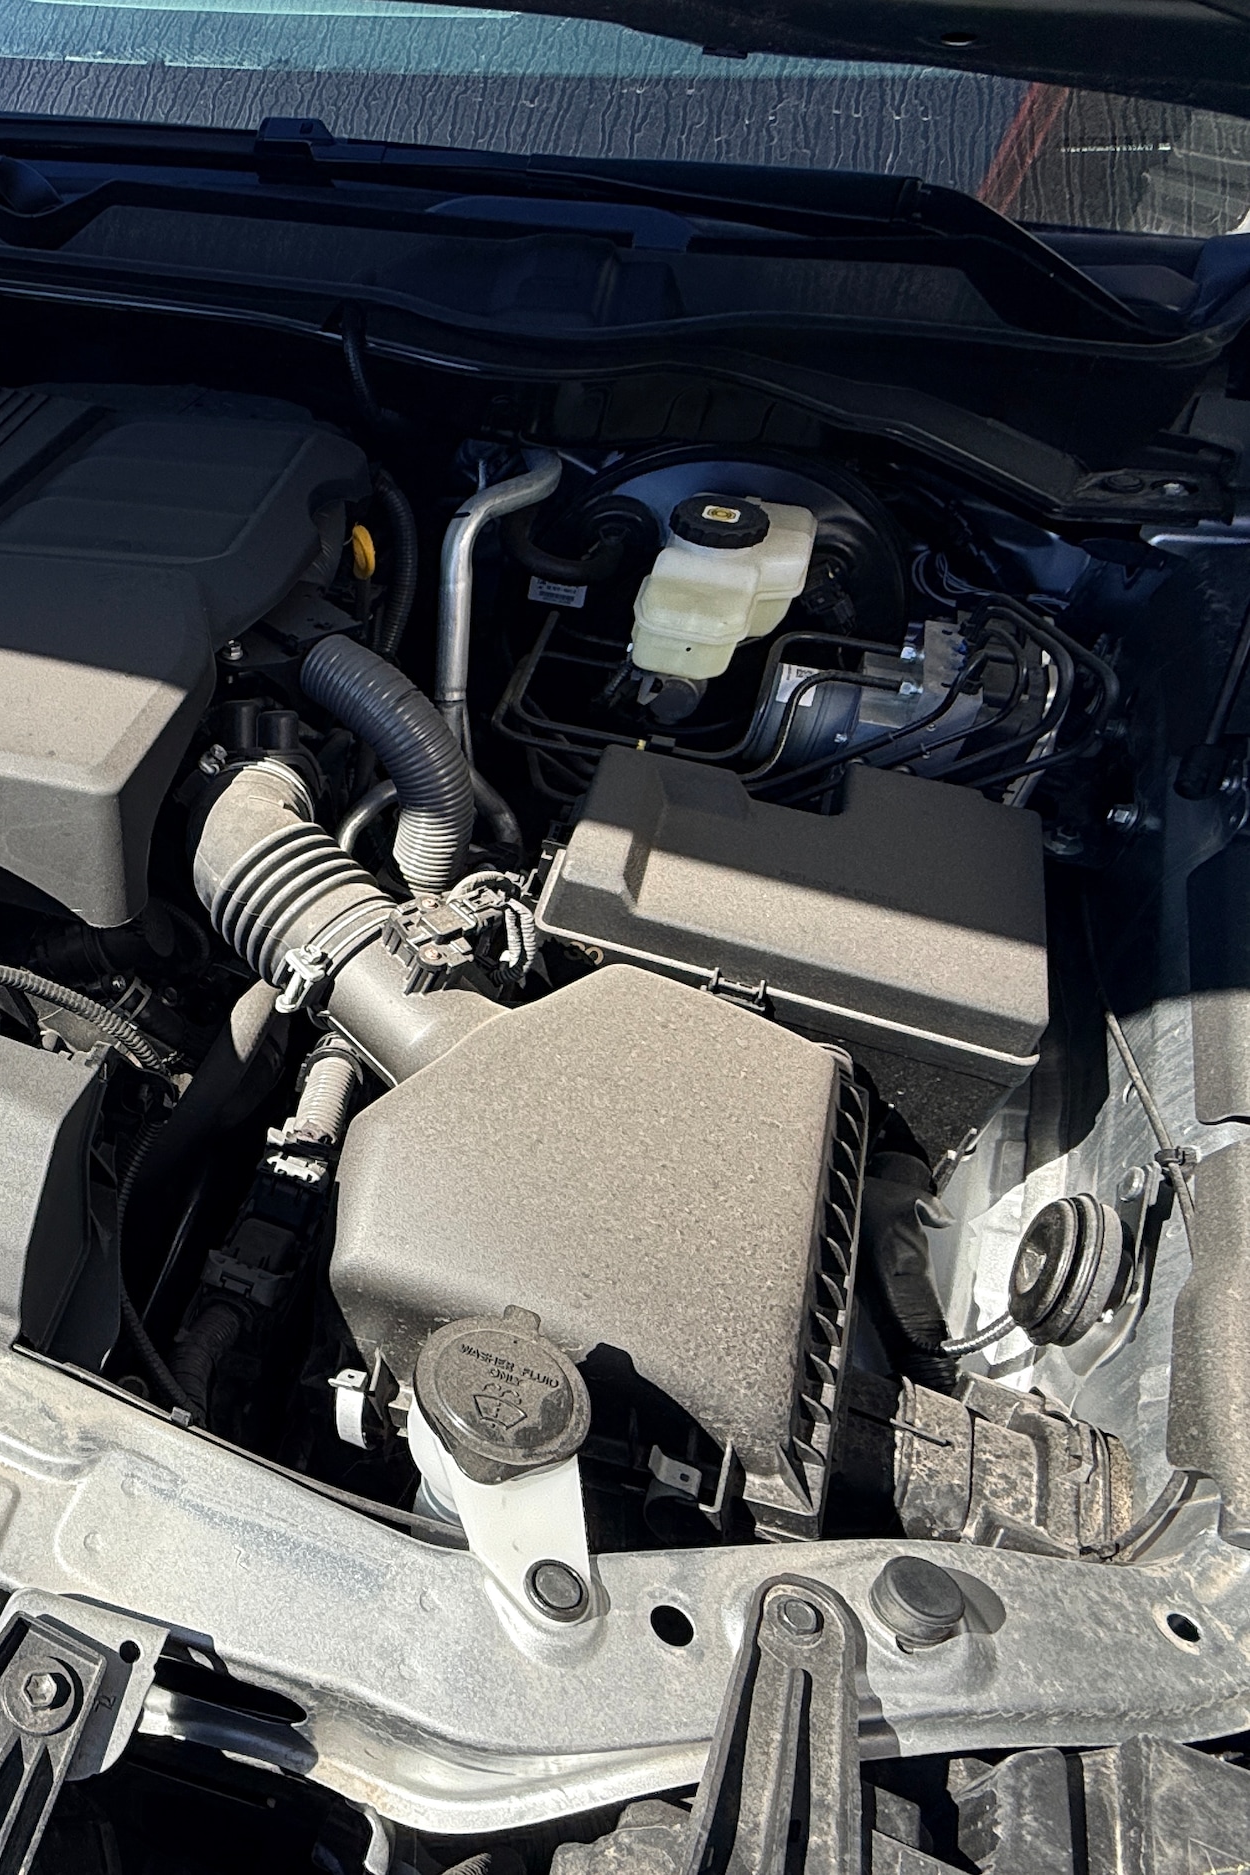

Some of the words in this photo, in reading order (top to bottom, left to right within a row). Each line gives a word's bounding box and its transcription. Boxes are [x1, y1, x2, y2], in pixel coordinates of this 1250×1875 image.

[459, 1343, 515, 1373] WASHER
[521, 1367, 560, 1389] FLUID
[490, 1367, 523, 1386] ONLY
